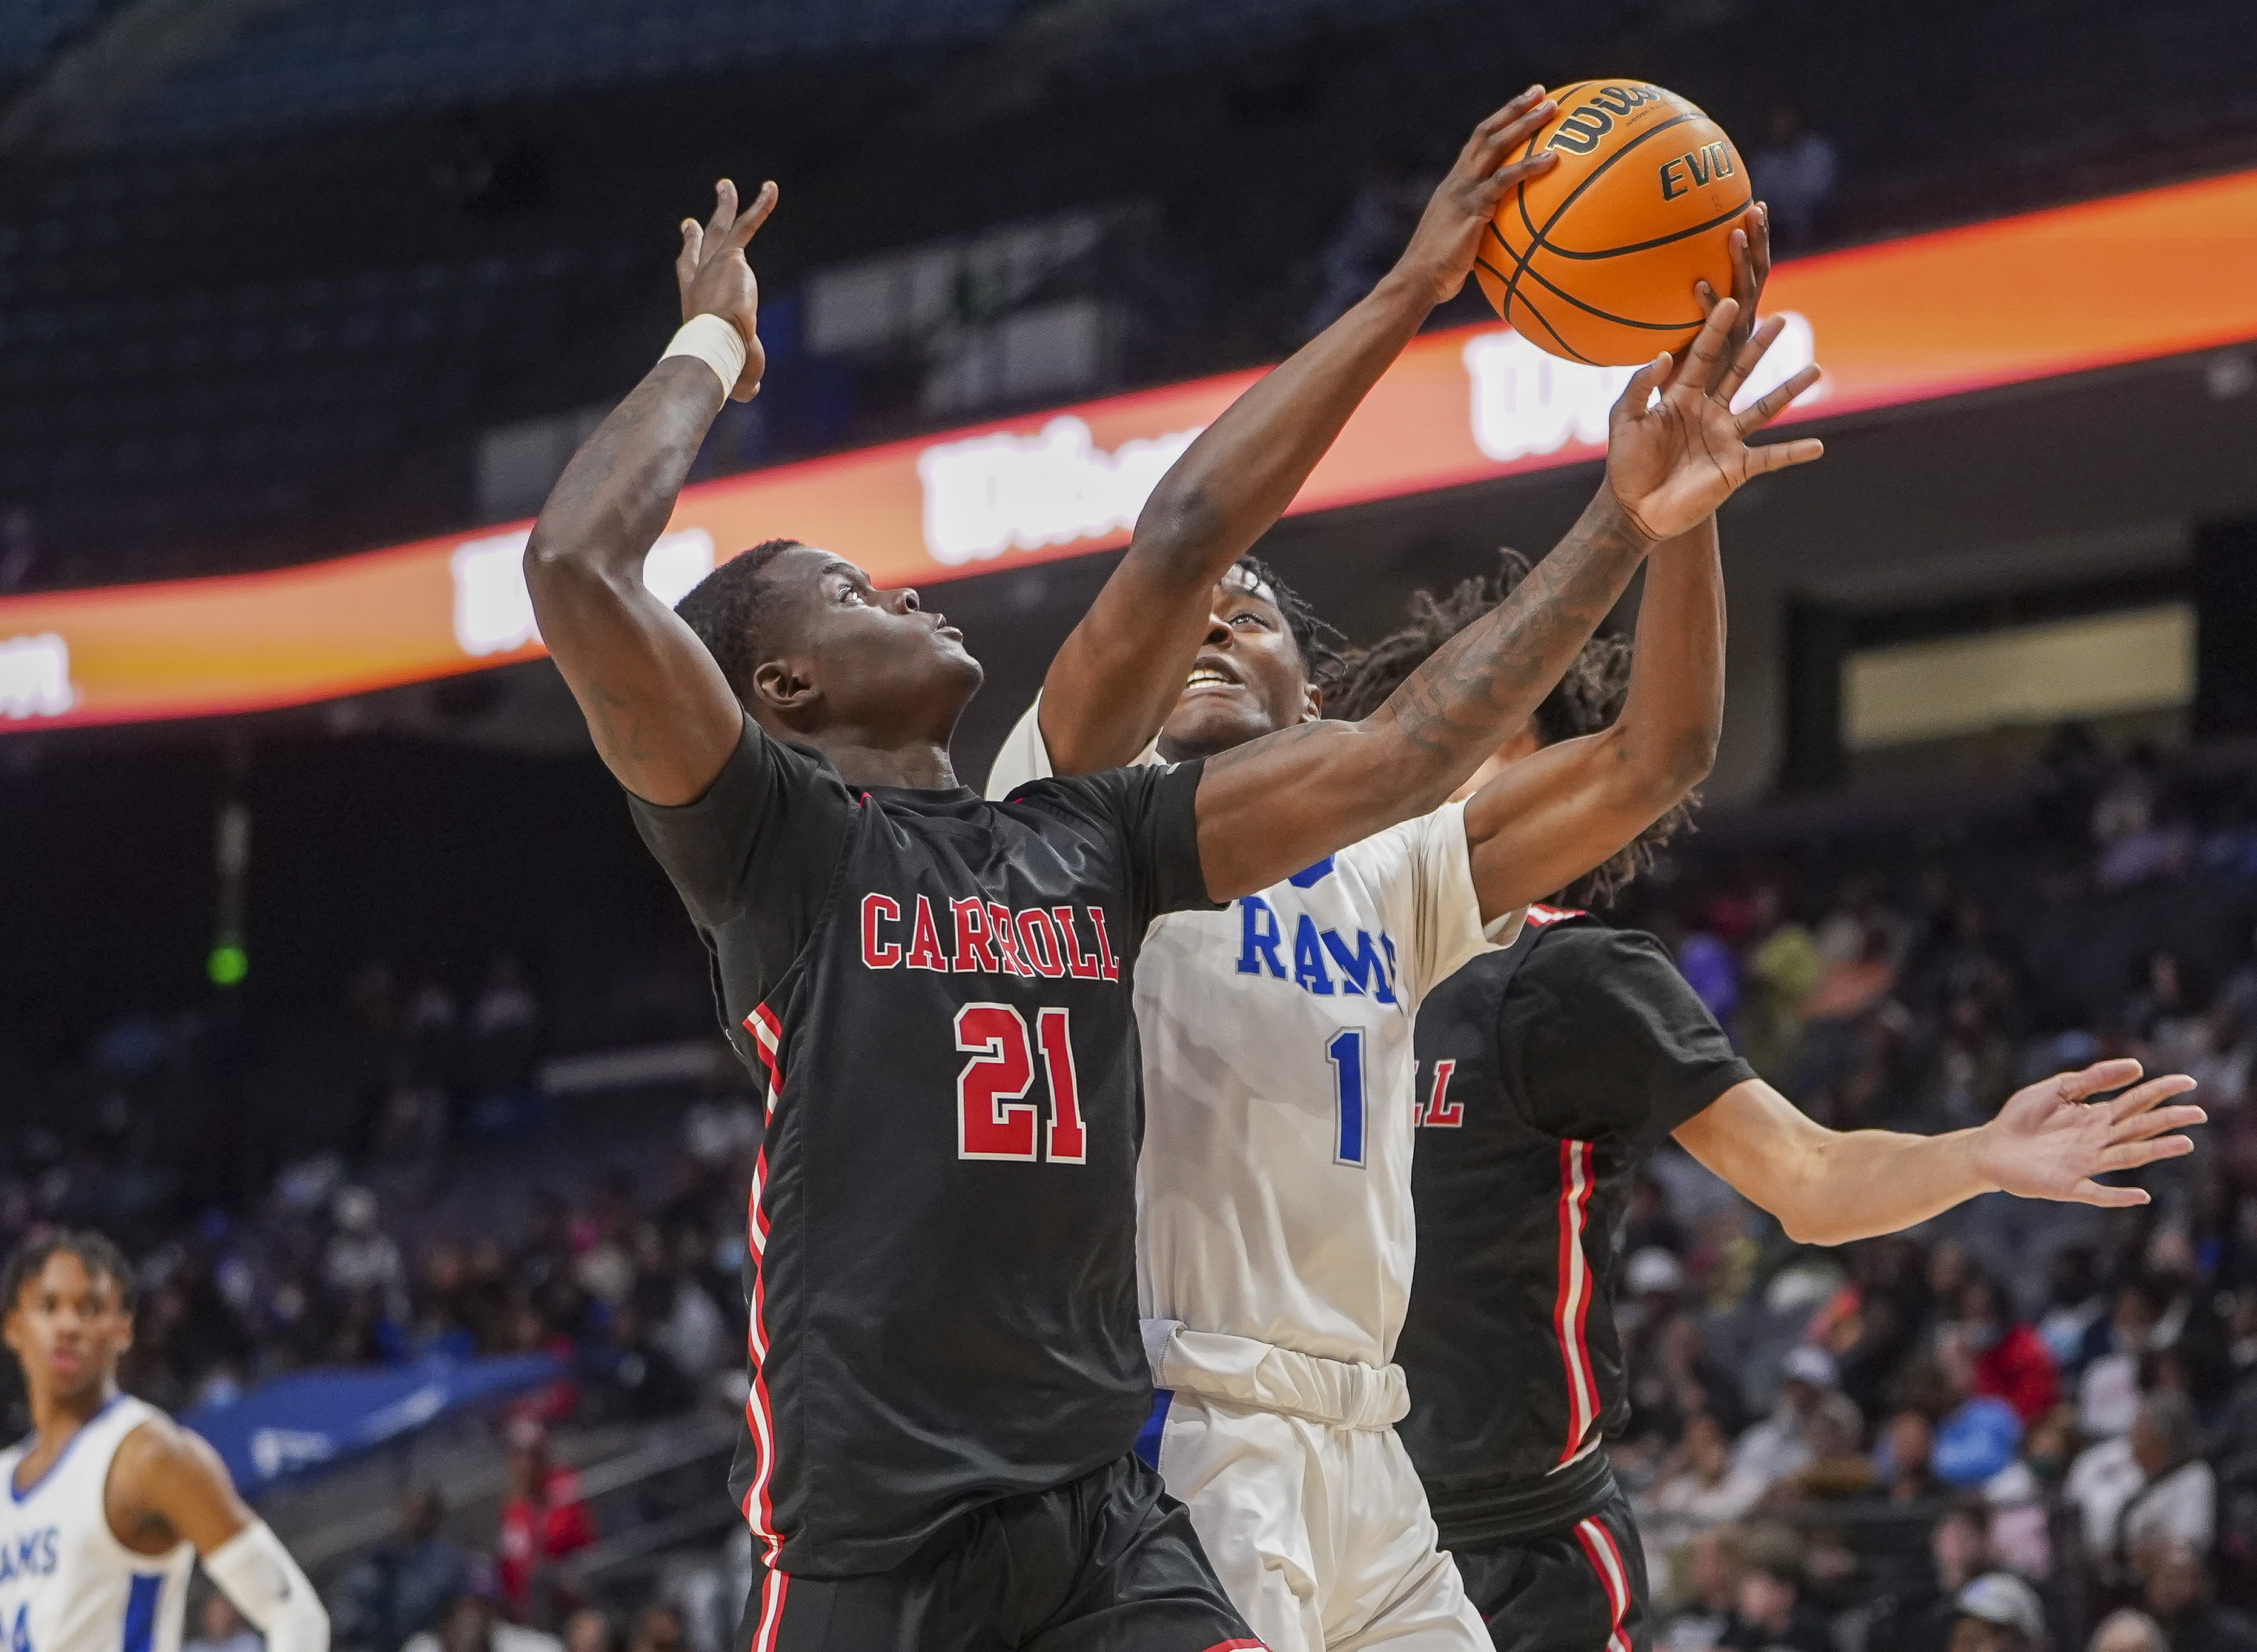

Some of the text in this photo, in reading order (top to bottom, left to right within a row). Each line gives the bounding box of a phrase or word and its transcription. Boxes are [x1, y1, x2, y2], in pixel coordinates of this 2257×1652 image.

[1659, 141, 1734, 203] EVO
[861, 892, 1119, 983] CARROLL
[953, 1002, 1087, 1165] 21
[1325, 1026, 1368, 1170] 1
